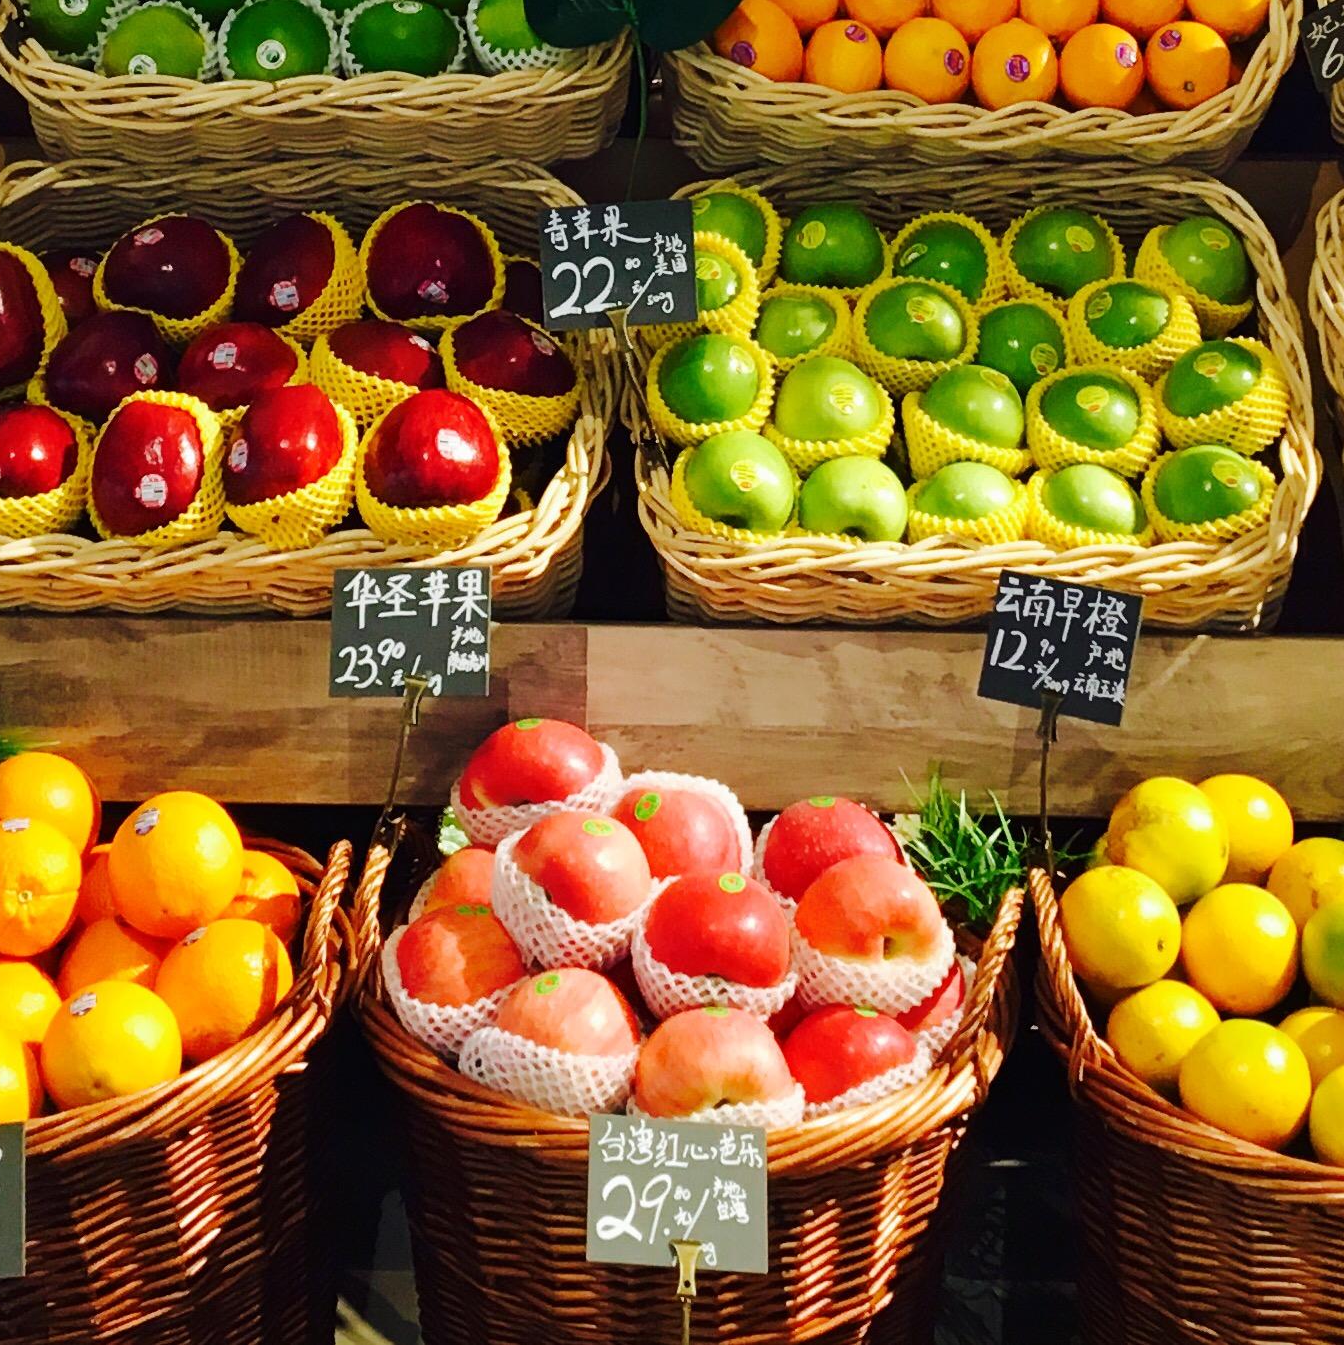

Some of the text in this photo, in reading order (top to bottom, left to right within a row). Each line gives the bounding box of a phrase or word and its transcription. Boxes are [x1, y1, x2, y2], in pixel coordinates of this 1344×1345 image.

[544, 205, 651, 251] 青苹果
[343, 570, 488, 629] 华圣苹果
[995, 577, 1128, 642] 云南早橙
[1085, 640, 1126, 671] 产地
[598, 1118, 763, 1168] 台湾红心芭乐
